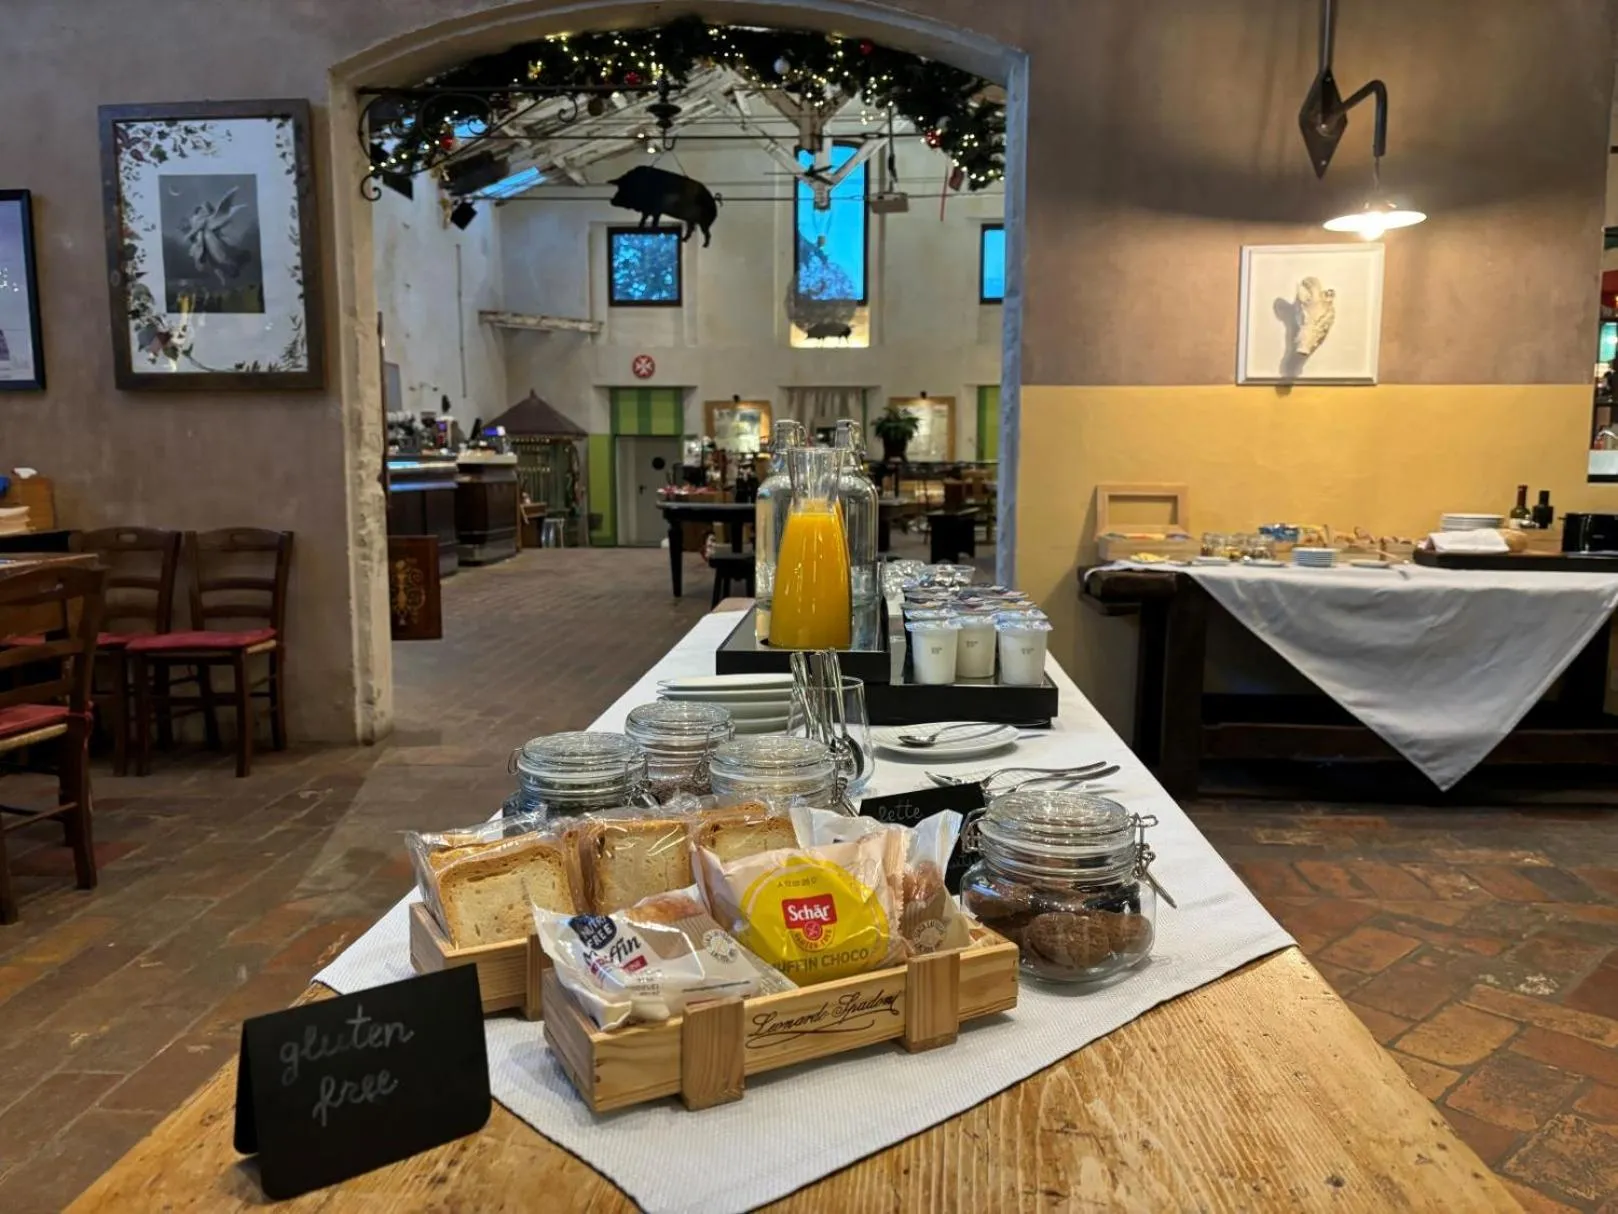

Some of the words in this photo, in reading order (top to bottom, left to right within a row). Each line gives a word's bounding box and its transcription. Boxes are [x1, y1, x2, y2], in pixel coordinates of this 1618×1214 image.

[787, 904, 830, 922] Schär
[586, 923, 613, 948] FREE
[582, 936, 641, 967] Mffin
[821, 948, 869, 968] CHOCO
[279, 1003, 415, 1086] gluten
[312, 1069, 399, 1127] free
